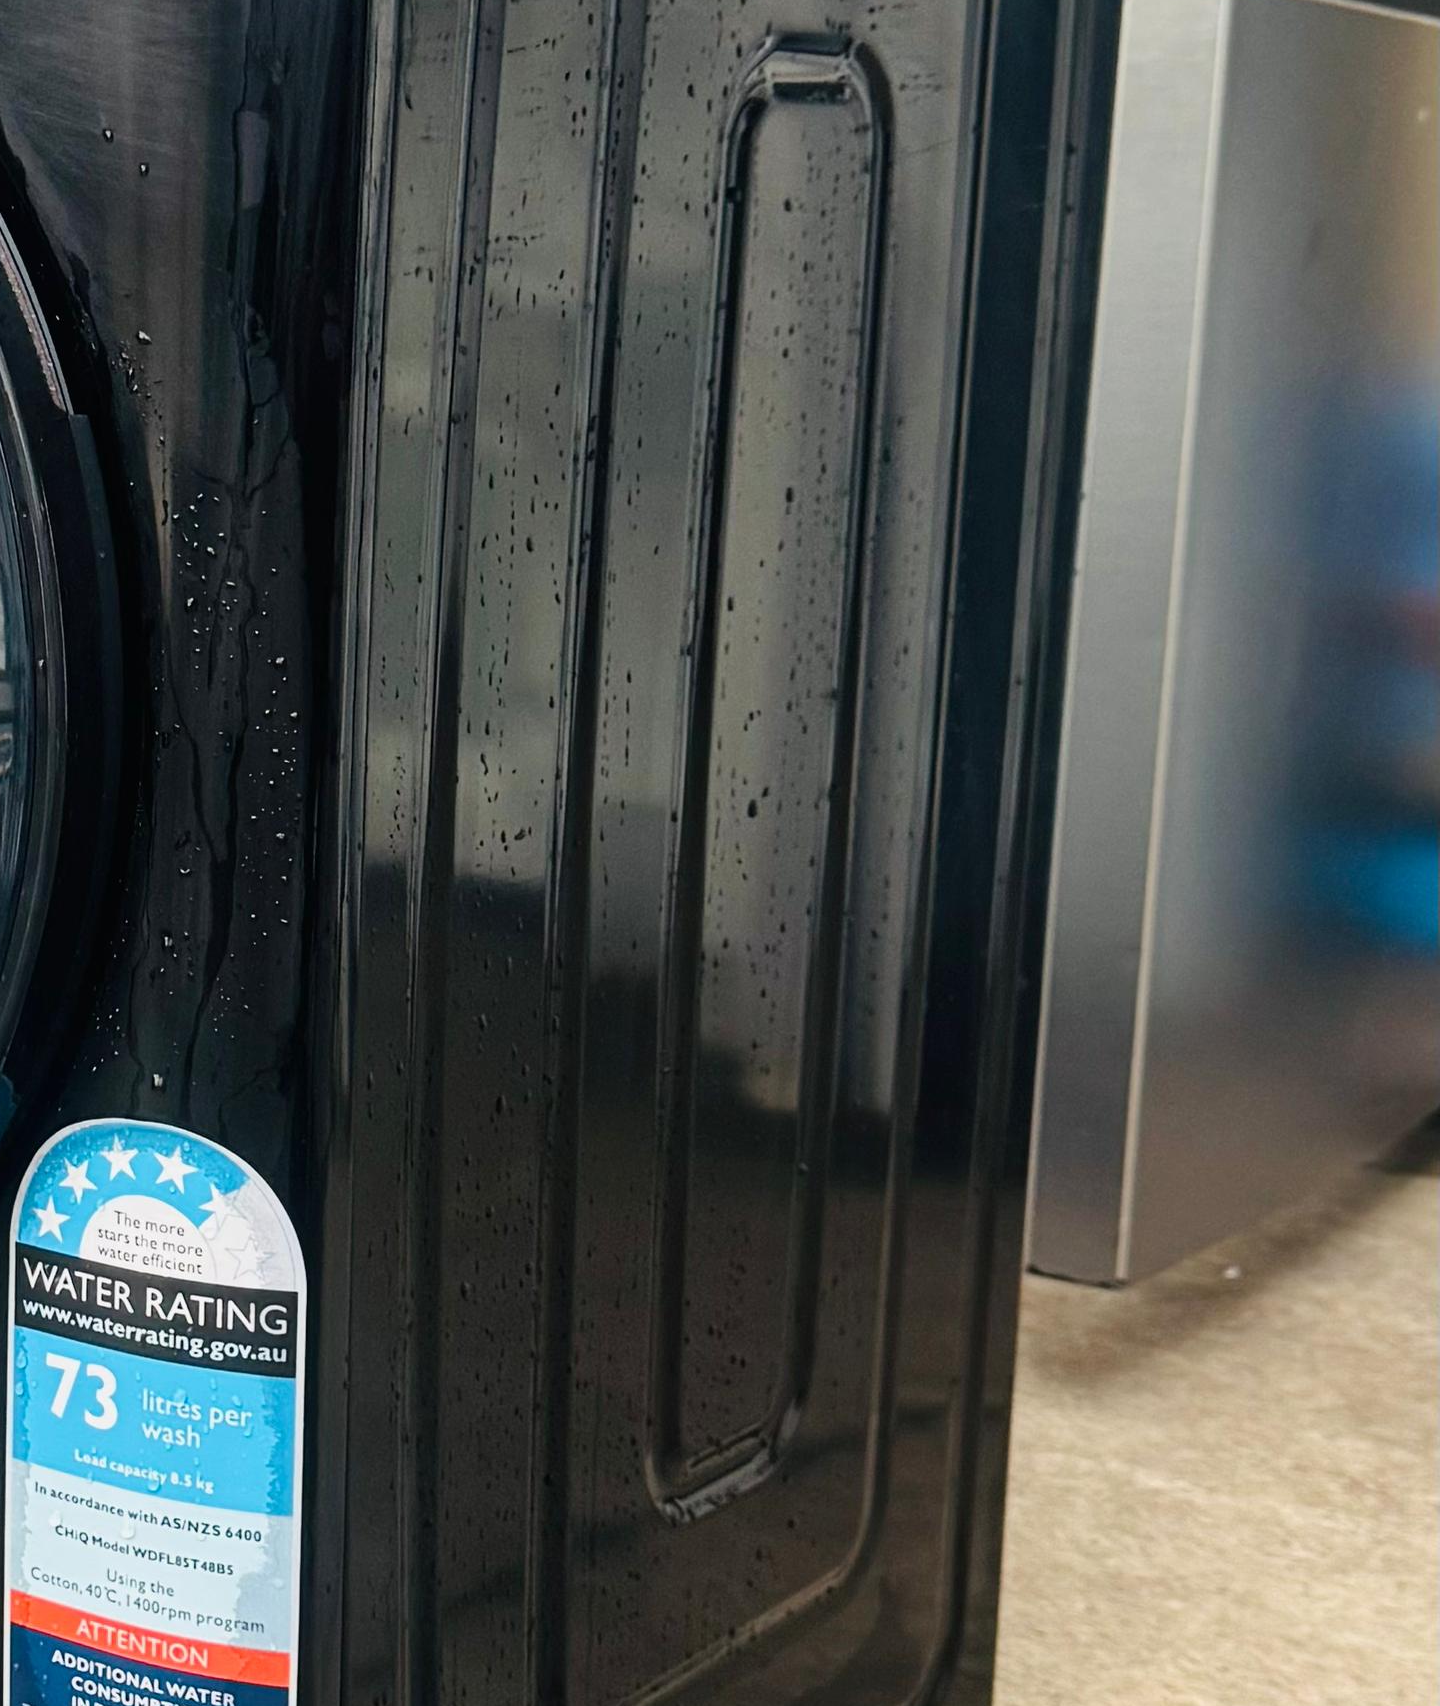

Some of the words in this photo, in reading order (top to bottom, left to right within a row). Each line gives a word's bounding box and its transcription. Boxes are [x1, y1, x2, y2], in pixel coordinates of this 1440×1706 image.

[98, 1227, 130, 1246] stars
[135, 1233, 158, 1250] the
[163, 1240, 203, 1257] more
[114, 1210, 141, 1229] The
[146, 1219, 185, 1237] more
[97, 1245, 137, 1263] water
[142, 1252, 203, 1275] efficient
[23, 1259, 135, 1314] WATER
[146, 1287, 288, 1335] RATING
[22, 1298, 288, 1363] www.waterrating.gov.au
[45, 1352, 118, 1431] 73
[142, 1389, 202, 1421] litres
[210, 1407, 252, 1432] per
[142, 1424, 201, 1449] wash
[74, 1449, 108, 1471] Load
[109, 1461, 168, 1485] capacity
[196, 1474, 214, 1493] kg
[34, 1481, 48, 1495] In
[50, 1488, 124, 1517] accordance
[128, 1510, 158, 1526] with
[161, 1515, 221, 1538] AS/NZS
[225, 1525, 262, 1543] 6400
[54, 1524, 89, 1547] CHiQ
[92, 1536, 130, 1555] Model
[132, 1545, 234, 1576] WDFL85T48B5
[30, 1566, 83, 1595] Cotton,
[126, 1595, 192, 1623] 1400rpm
[196, 1613, 265, 1635] program
[106, 1567, 146, 1595] Using
[151, 1580, 175, 1597] the
[76, 1618, 209, 1668] ATTENTION
[51, 1649, 164, 1695] ADDITIONAL
